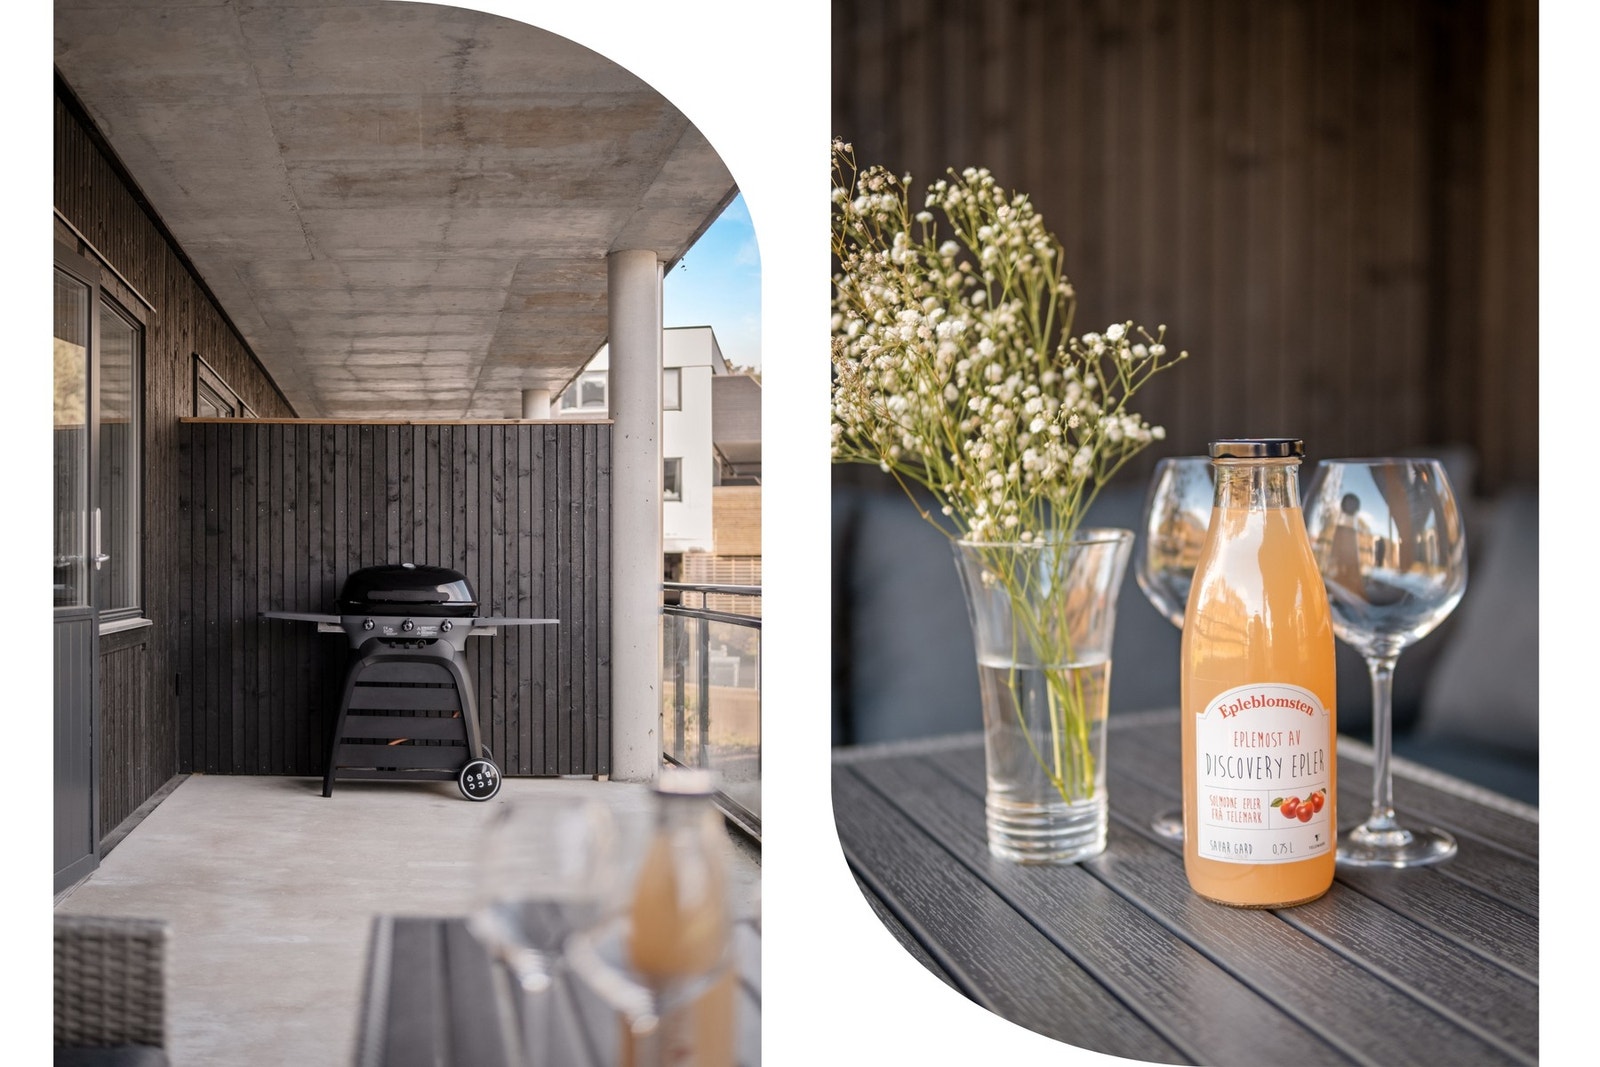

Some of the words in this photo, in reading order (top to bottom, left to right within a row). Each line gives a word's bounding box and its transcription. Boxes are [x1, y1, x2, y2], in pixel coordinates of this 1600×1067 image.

[1218, 694, 1315, 719] Epleblomsten
[1233, 731, 1283, 748] EPLEMOST
[1288, 729, 1301, 747] AV
[1205, 752, 1282, 780] DISCOVERY
[1292, 748, 1325, 778] EPLER
[1243, 797, 1262, 810] EPLER
[1226, 810, 1262, 824] TELEMARK
